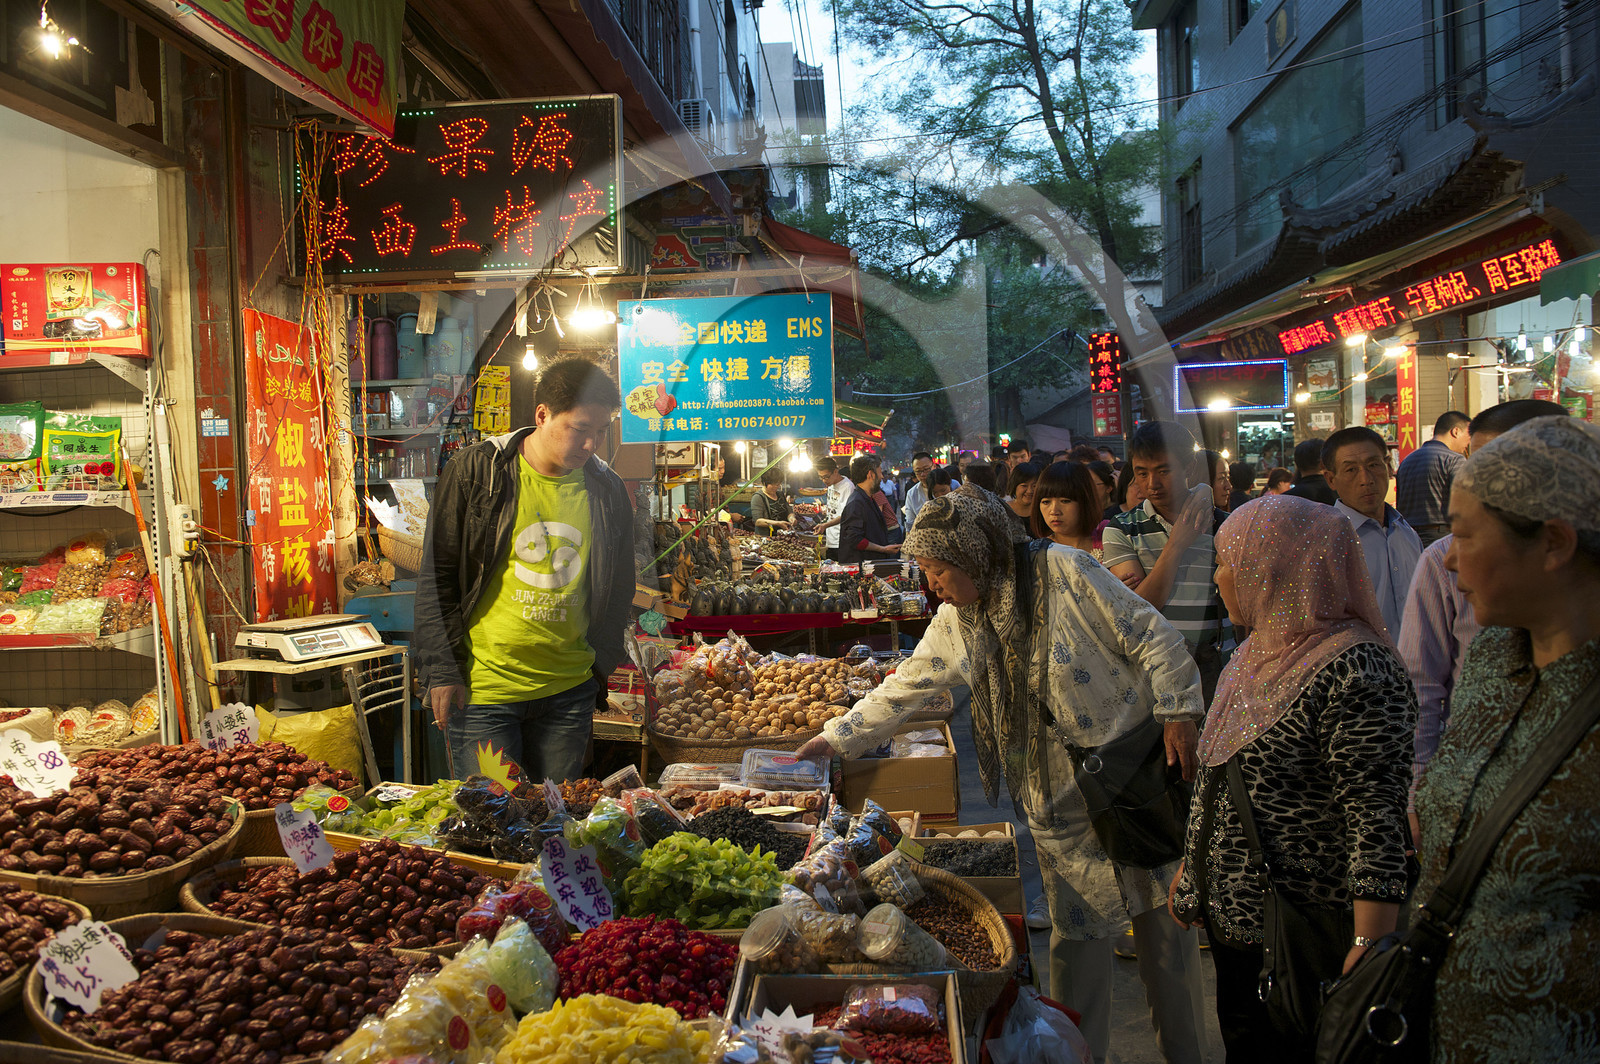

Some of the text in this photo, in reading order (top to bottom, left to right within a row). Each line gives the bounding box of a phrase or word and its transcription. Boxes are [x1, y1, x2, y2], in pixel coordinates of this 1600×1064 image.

[628, 317, 823, 348] 代全国快递 EMS
[641, 355, 811, 384] 安全 快捷 方便
[1097, 335, 1114, 390] 平顺旅馆
[717, 415, 807, 429] 18706740077
[522, 605, 568, 622] CANCER
